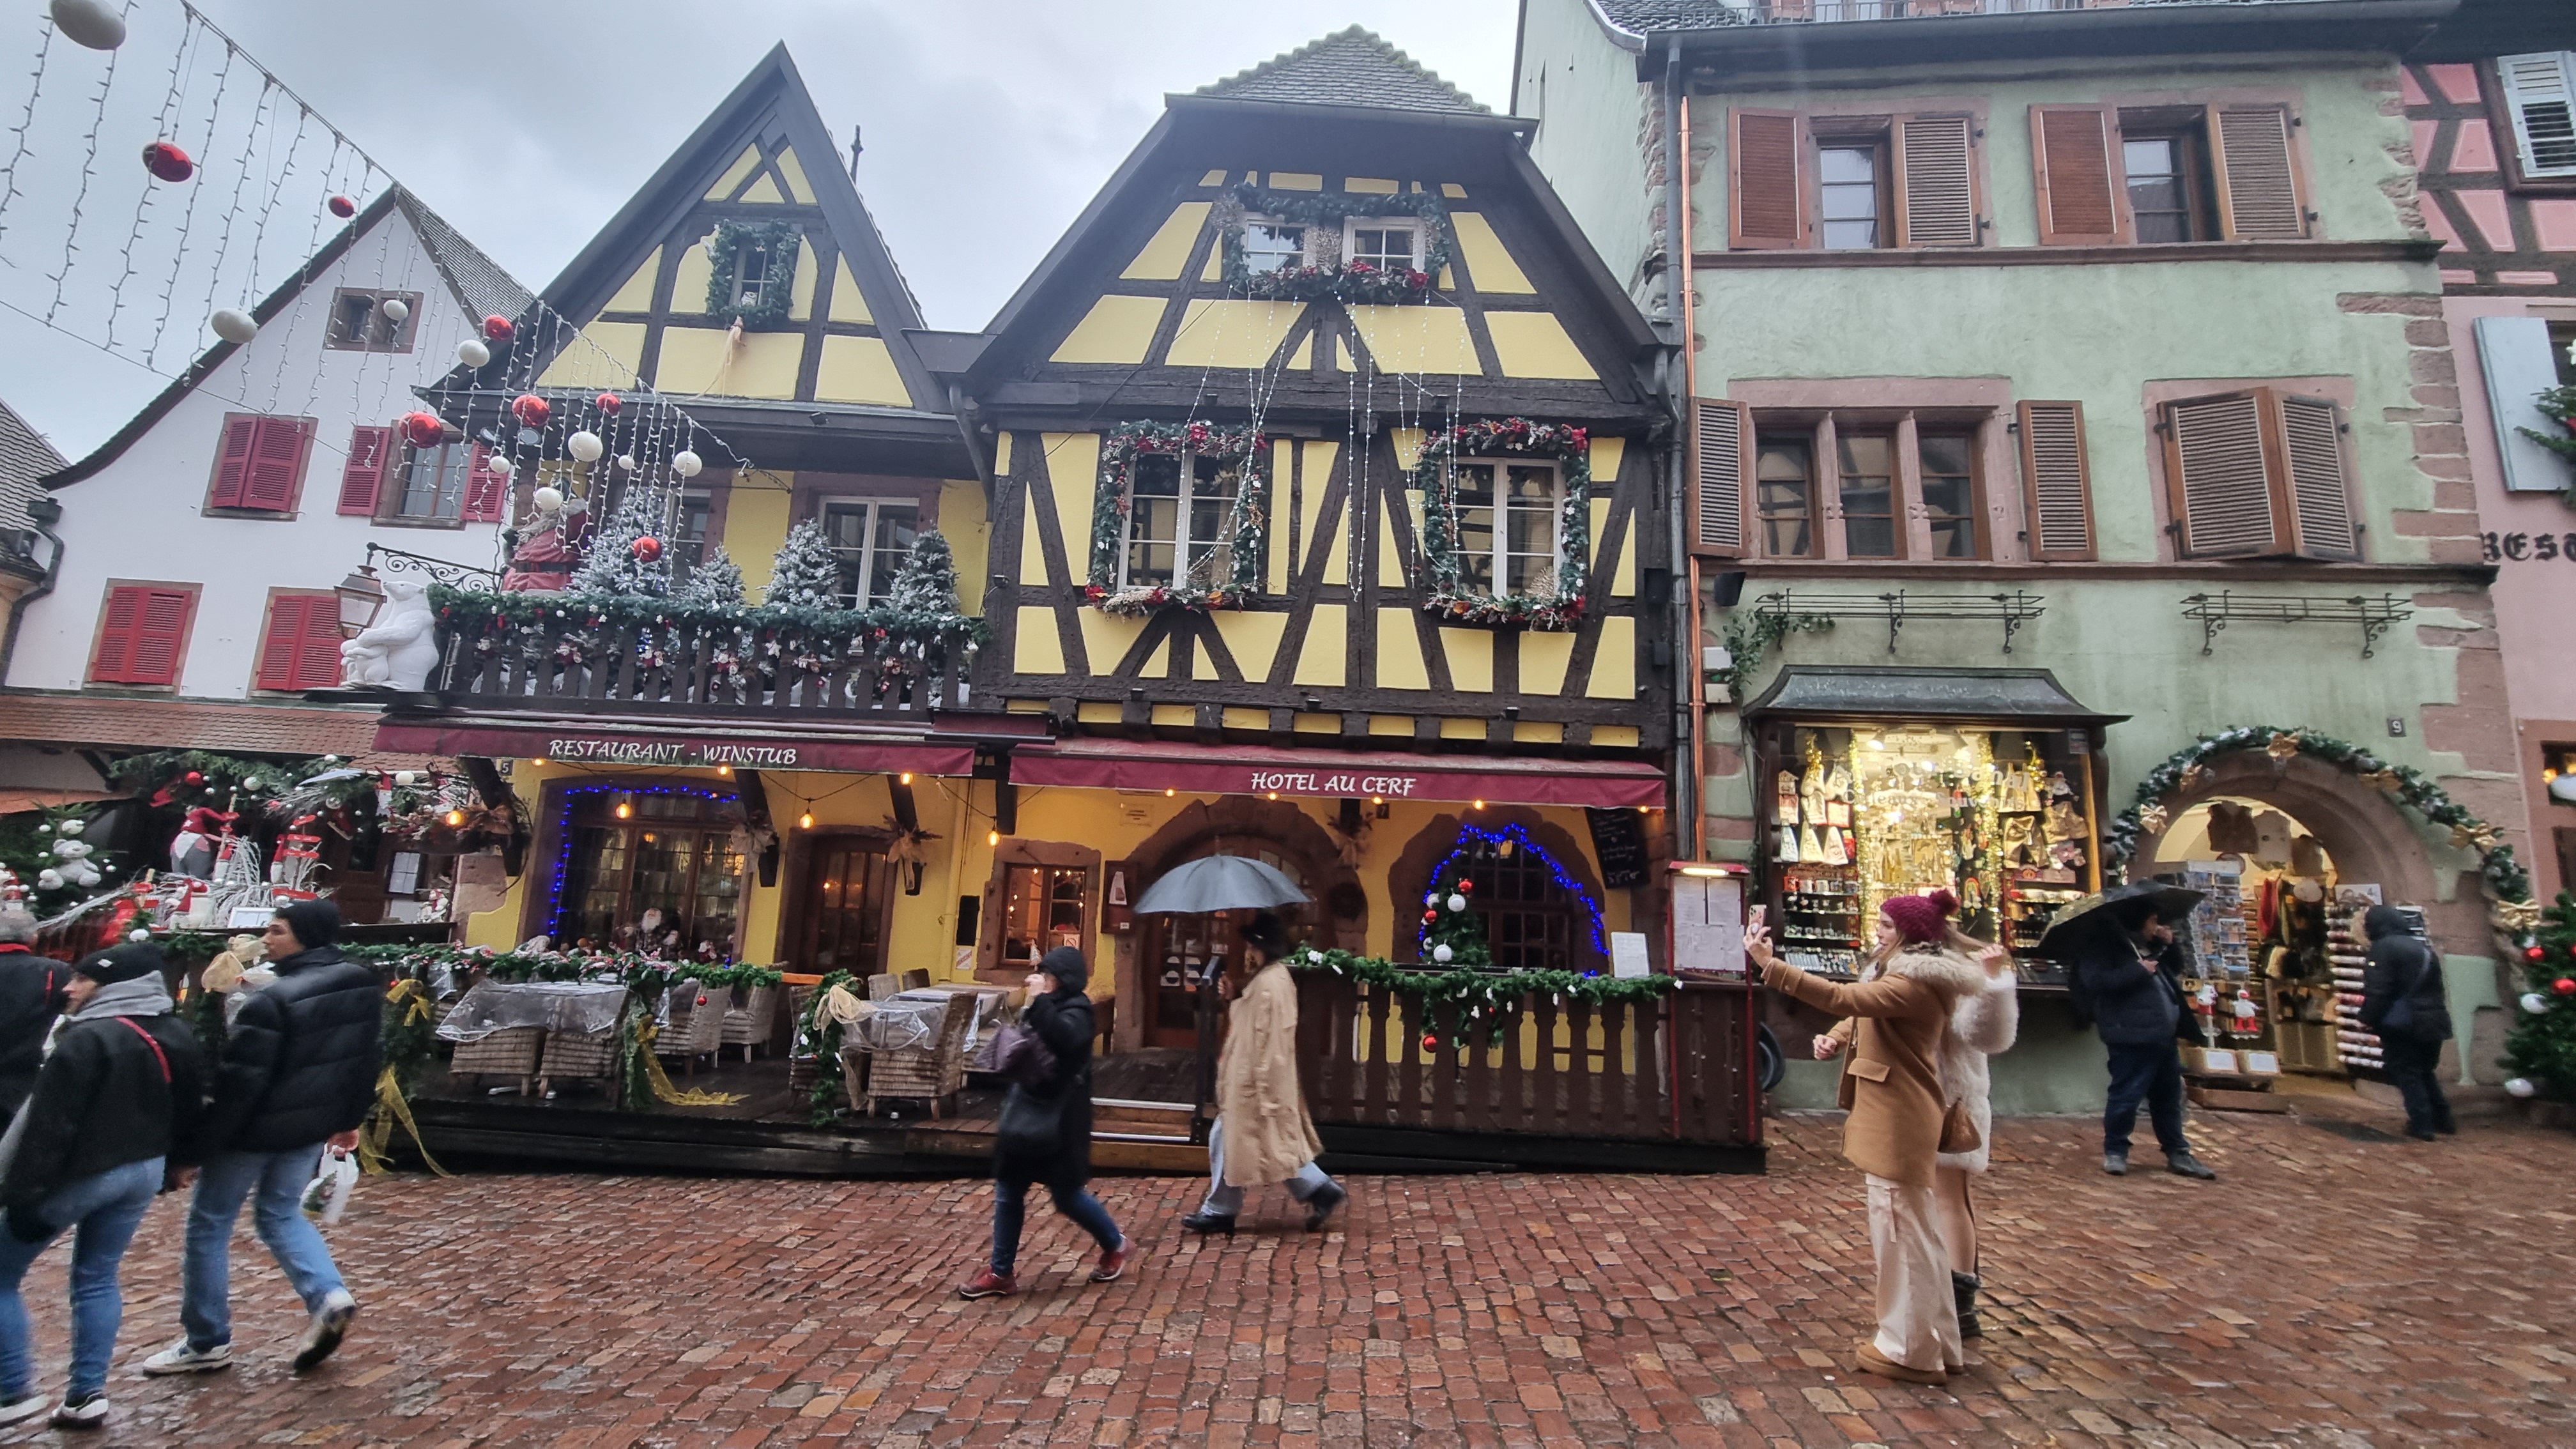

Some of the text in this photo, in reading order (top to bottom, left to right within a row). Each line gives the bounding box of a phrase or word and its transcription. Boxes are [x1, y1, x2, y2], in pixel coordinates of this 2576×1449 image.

[2392, 720, 2402, 733] 9
[549, 739, 684, 759] RESTAURANT
[703, 744, 797, 765] WINSTUB
[502, 762, 509, 773] 5
[1251, 772, 1416, 797] HOTEL AU CERF
[1381, 806, 1386, 816] 7
